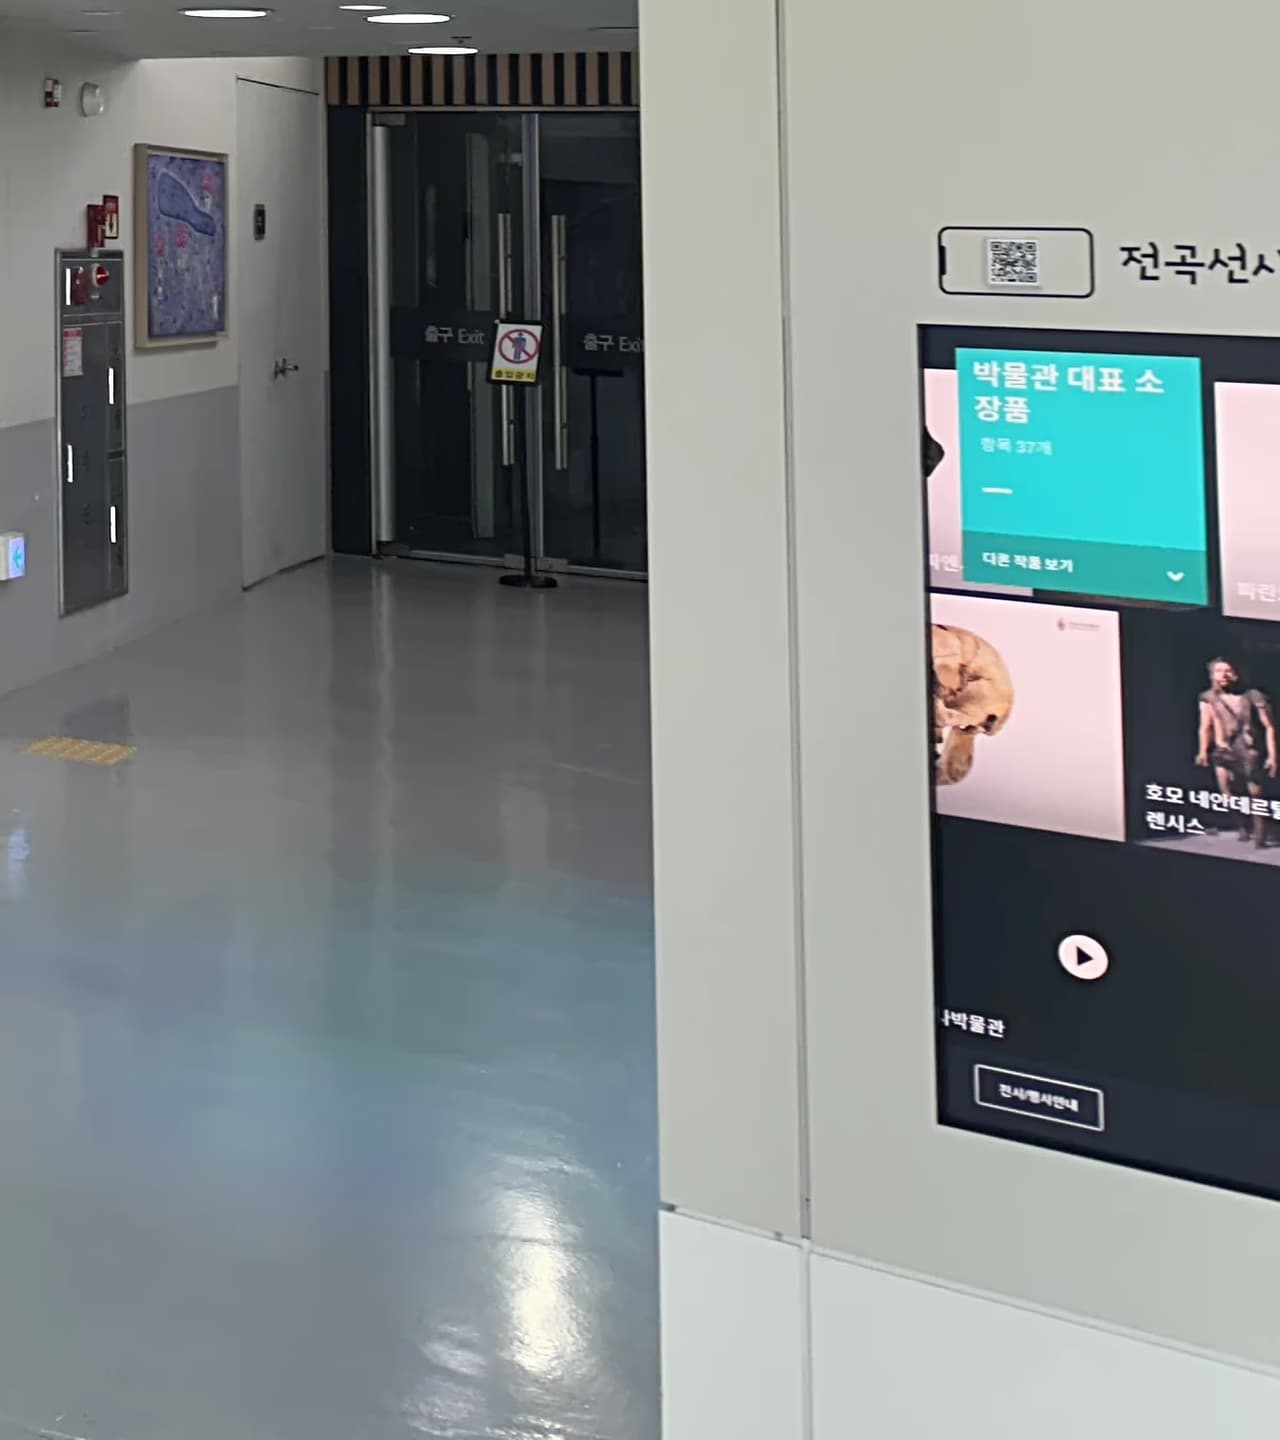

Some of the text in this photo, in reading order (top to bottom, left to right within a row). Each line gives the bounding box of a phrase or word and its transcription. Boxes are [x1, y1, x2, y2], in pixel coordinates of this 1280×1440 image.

[424, 325, 485, 345] 출구 Exit
[584, 333, 644, 353] 출구 Exi
[972, 361, 1166, 395] 박물관 대표 소
[973, 397, 1030, 424] 장품
[981, 551, 1074, 573] 다른 작품 보기
[1145, 783, 1185, 805] 호모
[1145, 811, 1206, 835] 렌시스
